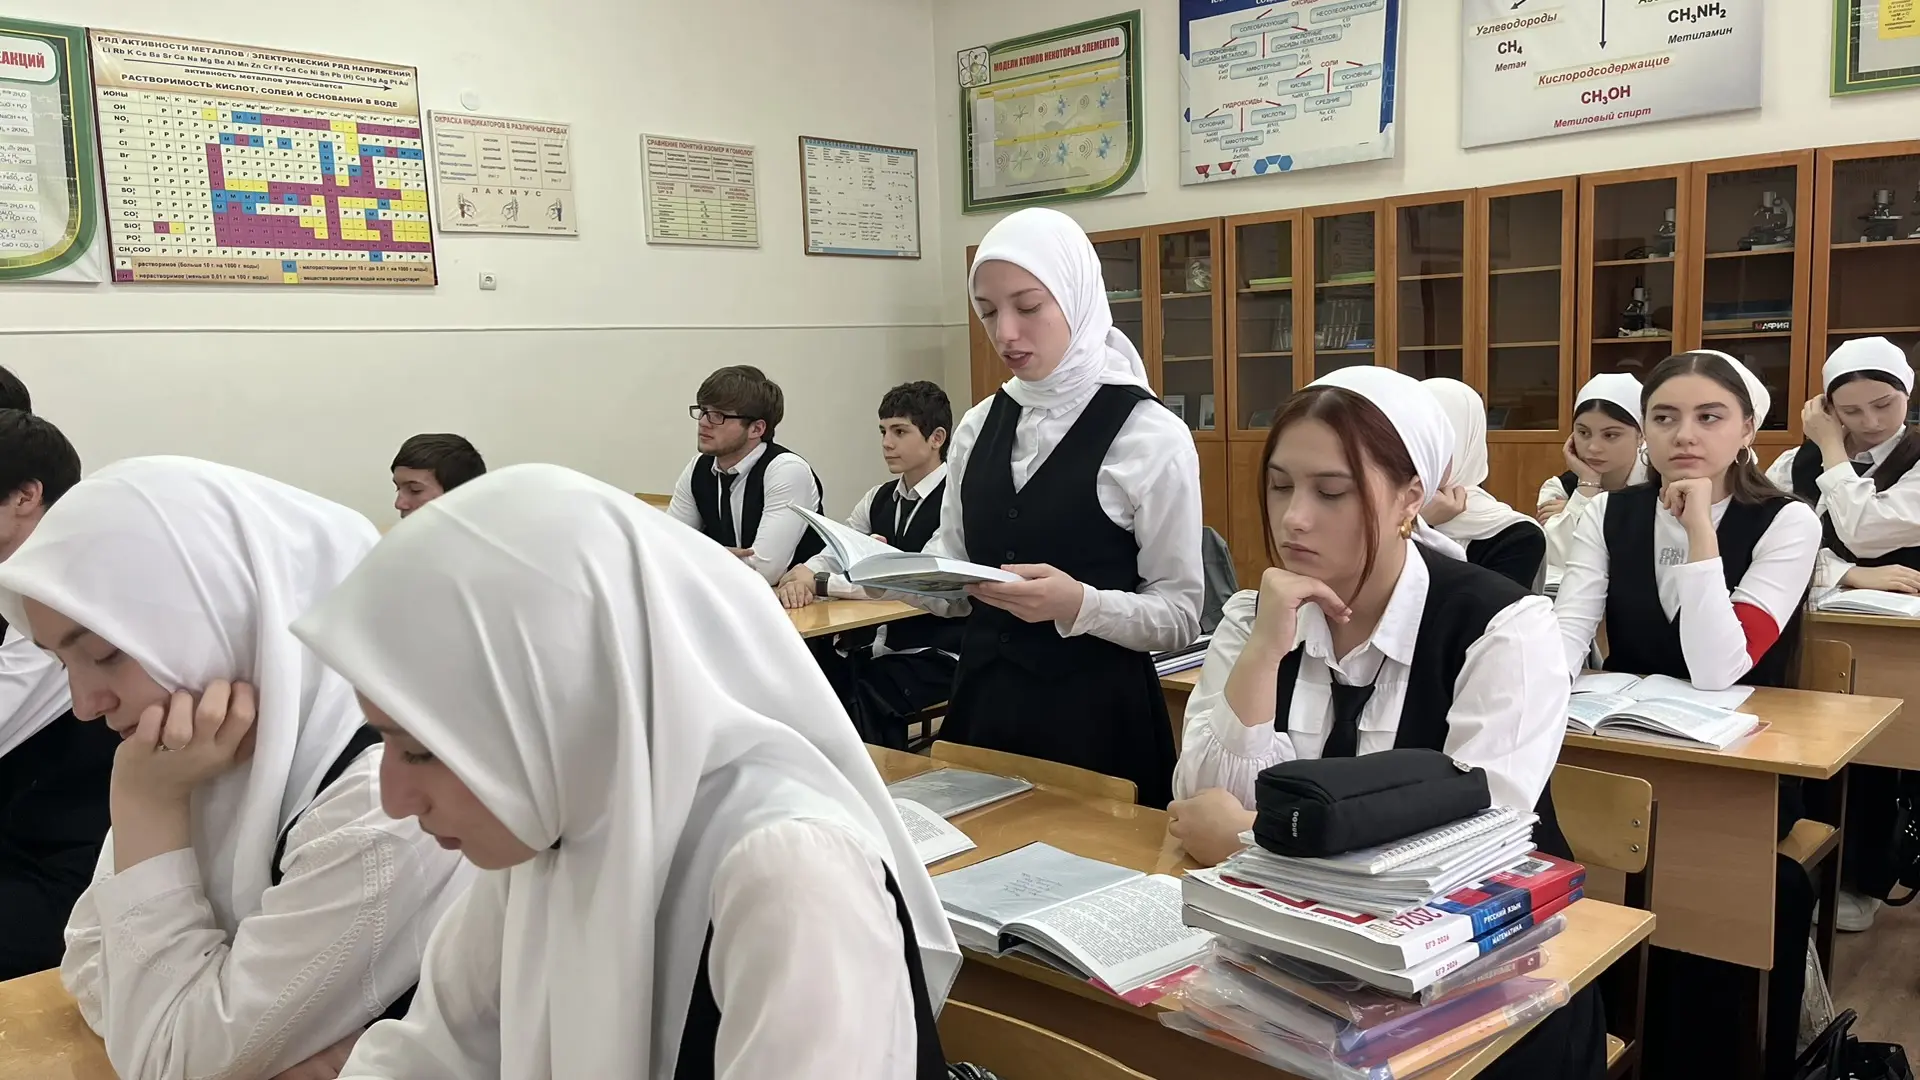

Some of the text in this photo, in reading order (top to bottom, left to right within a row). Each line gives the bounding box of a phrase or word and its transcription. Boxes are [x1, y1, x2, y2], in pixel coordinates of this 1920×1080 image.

[1240, 18, 1289, 32] СОЛЕОБРАЗУЮЩИЕ
[1475, 11, 1558, 36] Углеводороды
[1667, 27, 1733, 44] Метиламин
[97, 36, 119, 44] РЯД
[121, 38, 189, 50] АКТИВНОСТИ
[192, 46, 244, 57] МЕТАЛЛОВ
[252, 52, 330, 68] ЭЛЕКТРИЧЕСКИЙ
[332, 63, 350, 71] РЯД
[352, 66, 411, 77] НАПРЯЖЕНИЙ
[994, 36, 1120, 72] МОДЕЛИ АТОМОВ НЕКОТОРЫХ ЭЛЕМЕНТОВ
[1209, 46, 1238, 56] ОСНОВНЫЕ
[0, 51, 45, 69] АКЦИЙ
[1246, 62, 1281, 72] АМФОТЕРНЫЕ
[1320, 60, 1339, 68] СОЛИ
[1494, 59, 1527, 73] Метан
[1342, 70, 1373, 80] ОСНОВНЫЕ
[1538, 54, 1671, 87] Кислородсодержащие
[184, 68, 343, 90] активность металлов уменьшается
[1290, 81, 1312, 89] КИСЛЫЕ
[103, 90, 128, 98] ИОНЫ
[121, 74, 213, 88] РАСТВОРИМОСТЬ
[216, 83, 258, 94] КИСЛОТ,
[261, 87, 294, 97] СОЛЕЙ
[306, 92, 363, 103] ОСНОВАНИЙ
[374, 100, 398, 108] ВОДЕ
[1222, 98, 1263, 110] ГИДРОКСИДЫ
[1315, 96, 1341, 106] СРЕДНИЕ
[1261, 111, 1287, 119] КИСЛОТЫ
[1554, 105, 1652, 129] Метиловый спирт
[434, 115, 462, 124] ОКРАСКА
[511, 124, 545, 133] РАЗЛИЧНЫХ
[546, 126, 567, 135] СРЕДАХ
[647, 138, 678, 149] СРАВНЕНИЕ
[679, 142, 703, 150] ПОНЯТИЙ
[1225, 136, 1259, 145] АМФОТЕРНЫЕ
[1389, 906, 1442, 930] 2026
[1484, 902, 1522, 924] РУССКИЙ ЯЗЫК
[1491, 923, 1523, 944] МАТЕМАТИКА
[1425, 934, 1450, 950] ЕГЭ 2026
[1435, 967, 1446, 977] ЕГЭ
[1446, 960, 1458, 973] 2026
